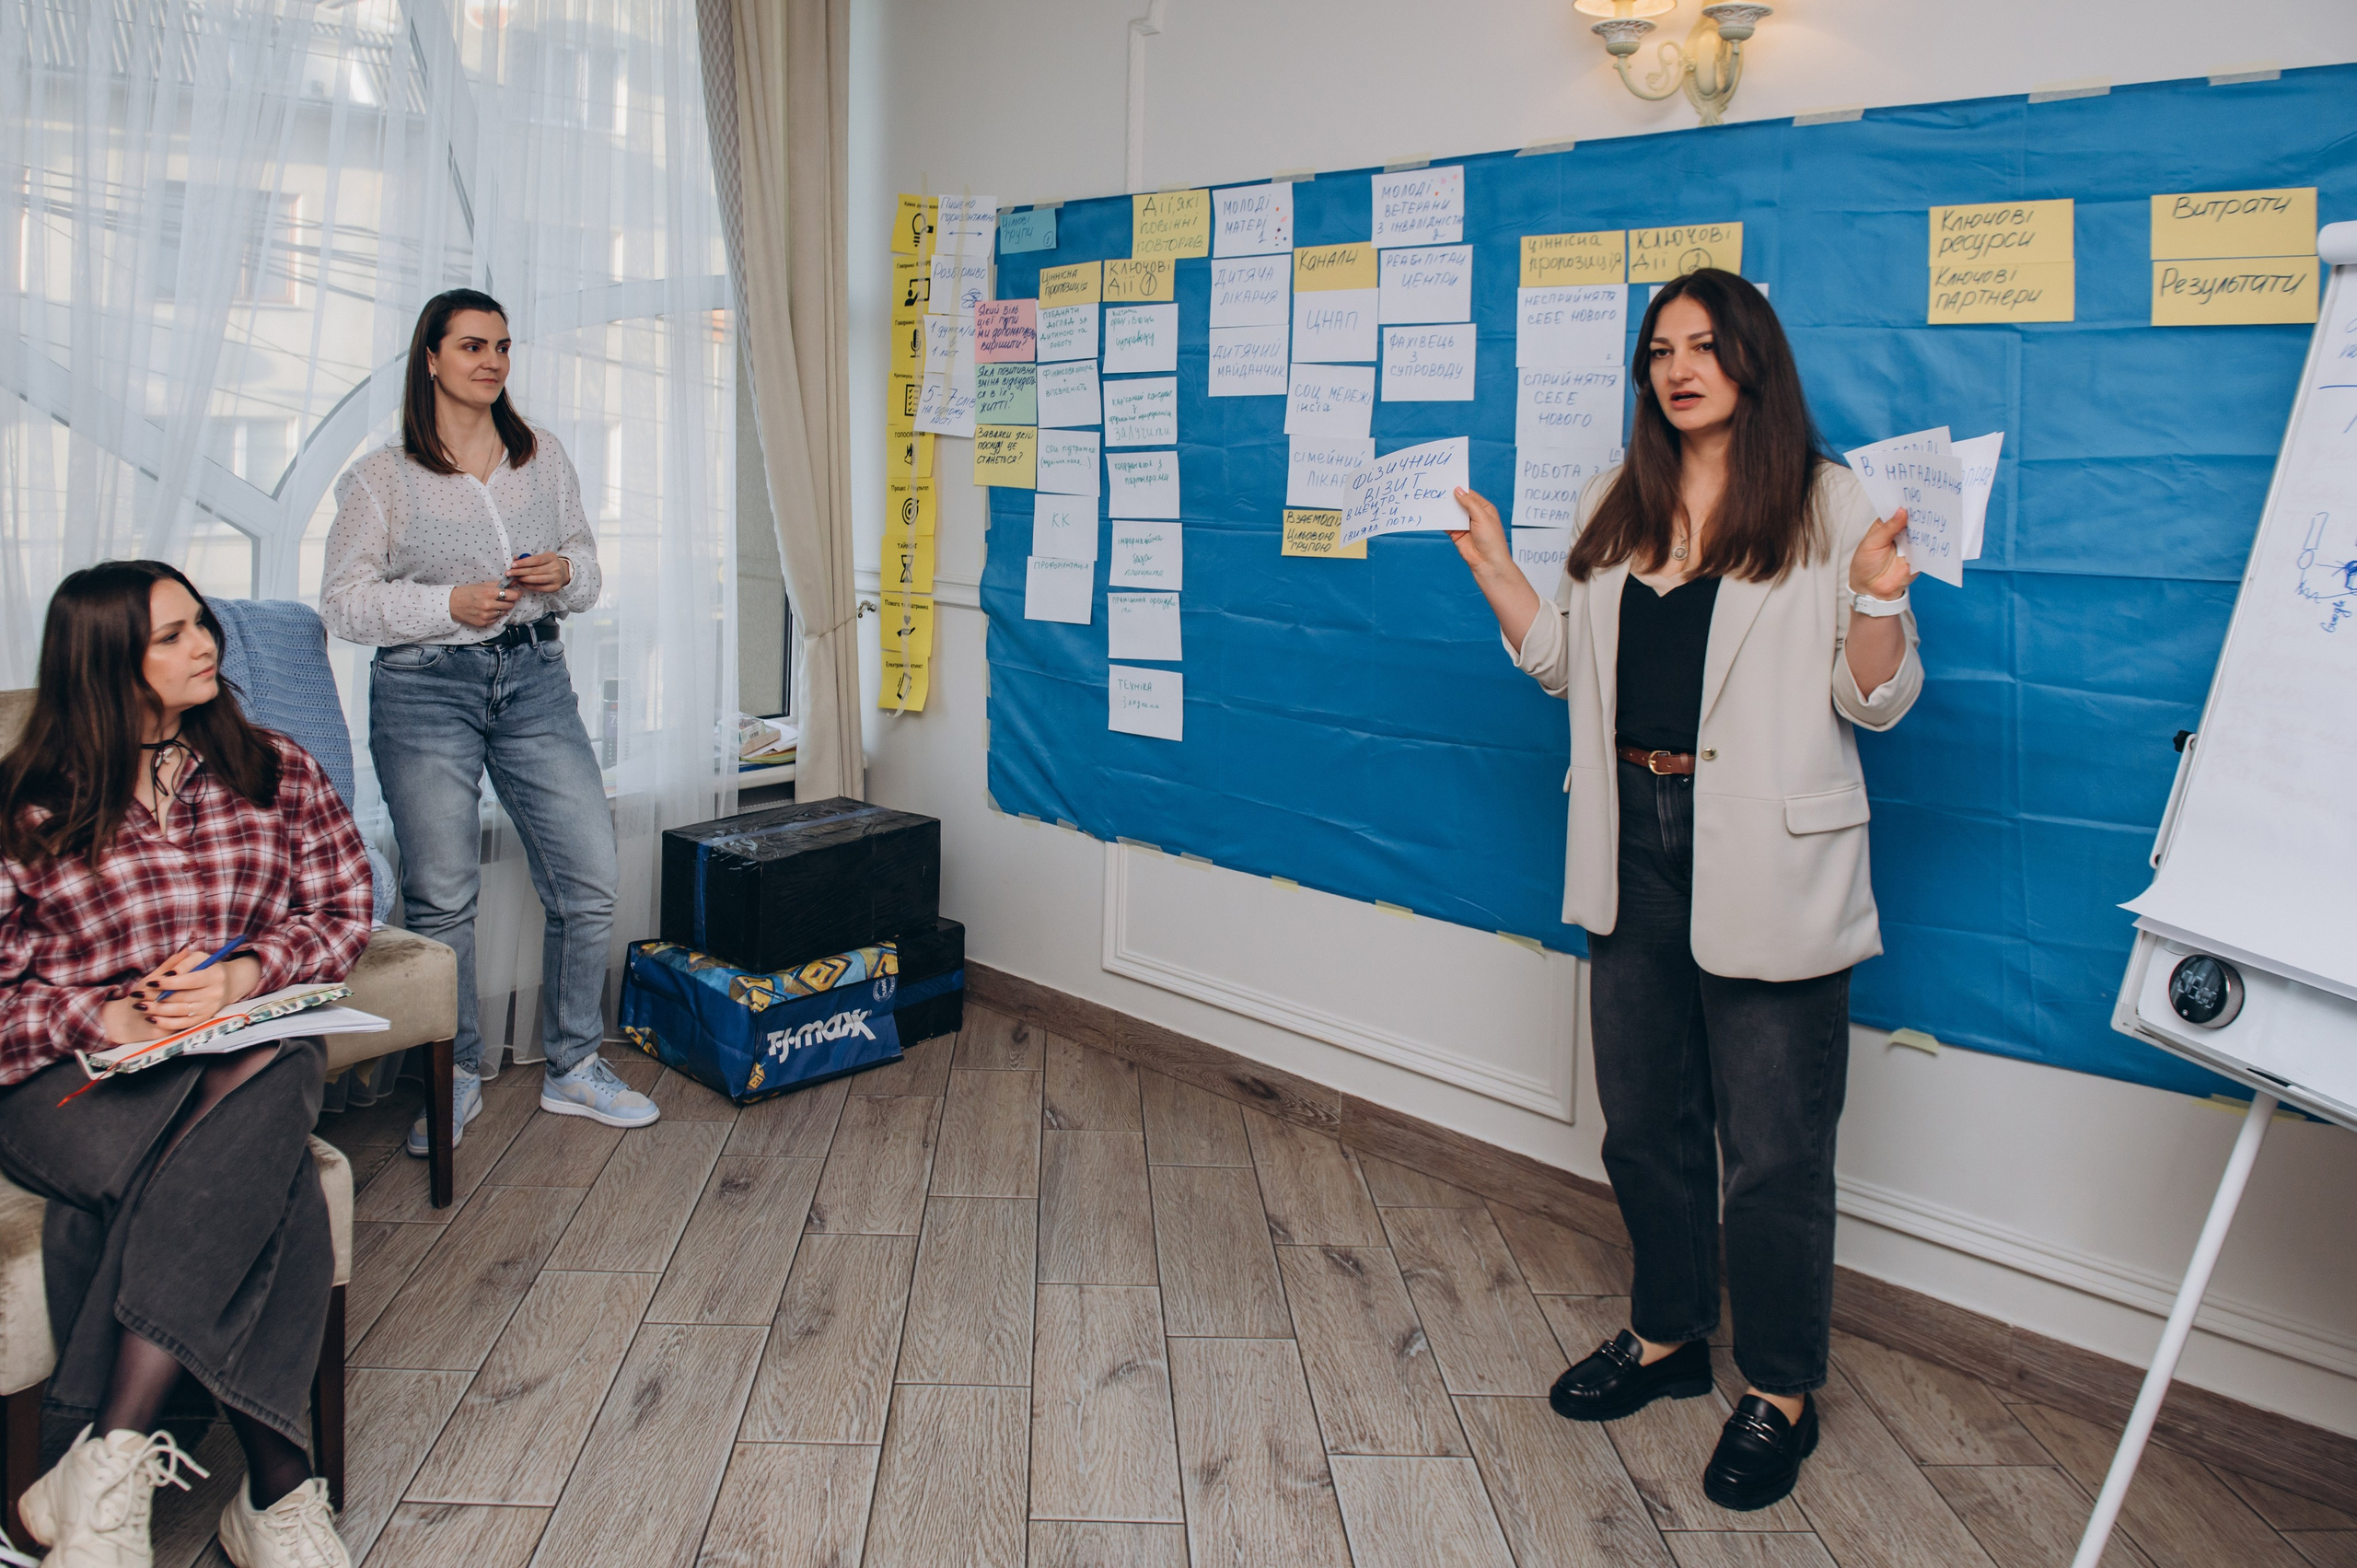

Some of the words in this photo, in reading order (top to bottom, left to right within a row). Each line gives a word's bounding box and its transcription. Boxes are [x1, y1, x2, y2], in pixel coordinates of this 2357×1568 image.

[1381, 179, 1434, 199] МОЛОДІ
[1224, 193, 1271, 215] МОЛОДІ
[1385, 200, 1451, 217] ВЕТЕРАНИ
[2172, 196, 2293, 222] Витрати
[1225, 215, 1269, 235] МАТЕРІ
[1938, 230, 2036, 260] ресурси
[1214, 266, 1274, 286] ДИТЯЧА
[1401, 271, 1458, 288] ЦЕНТРИ
[2160, 267, 2307, 305] Результати
[1219, 289, 1278, 306] ЛІКАРНЯ
[1306, 309, 1358, 335] ЦНАП
[1528, 310, 1564, 324] СЕБЕ
[1571, 309, 1617, 322] НОВОГО
[1213, 338, 1281, 360] ДИТЯЧИЙ
[1390, 333, 1455, 351] ФАХІВЕЦЬ
[1217, 363, 1285, 378] МАЙДАНЧИК
[1390, 362, 1463, 379] СУПРОВОДУ
[1524, 371, 1618, 388] СПРИЙНЯТТЯ
[1295, 384, 1321, 404] СОЦ
[1329, 386, 1372, 405] МЕРЕЖІ
[1534, 390, 1579, 405] СЕБЕ
[1538, 412, 1592, 427] НОВОГО
[1353, 446, 1455, 490] ФІЗИЧНИЙ
[1524, 461, 1581, 479] РОБОТА
[1364, 472, 1427, 504] ВІЗИТ
[1903, 486, 1922, 503] ПРО
[1906, 507, 1946, 533] АСТУПНУ
